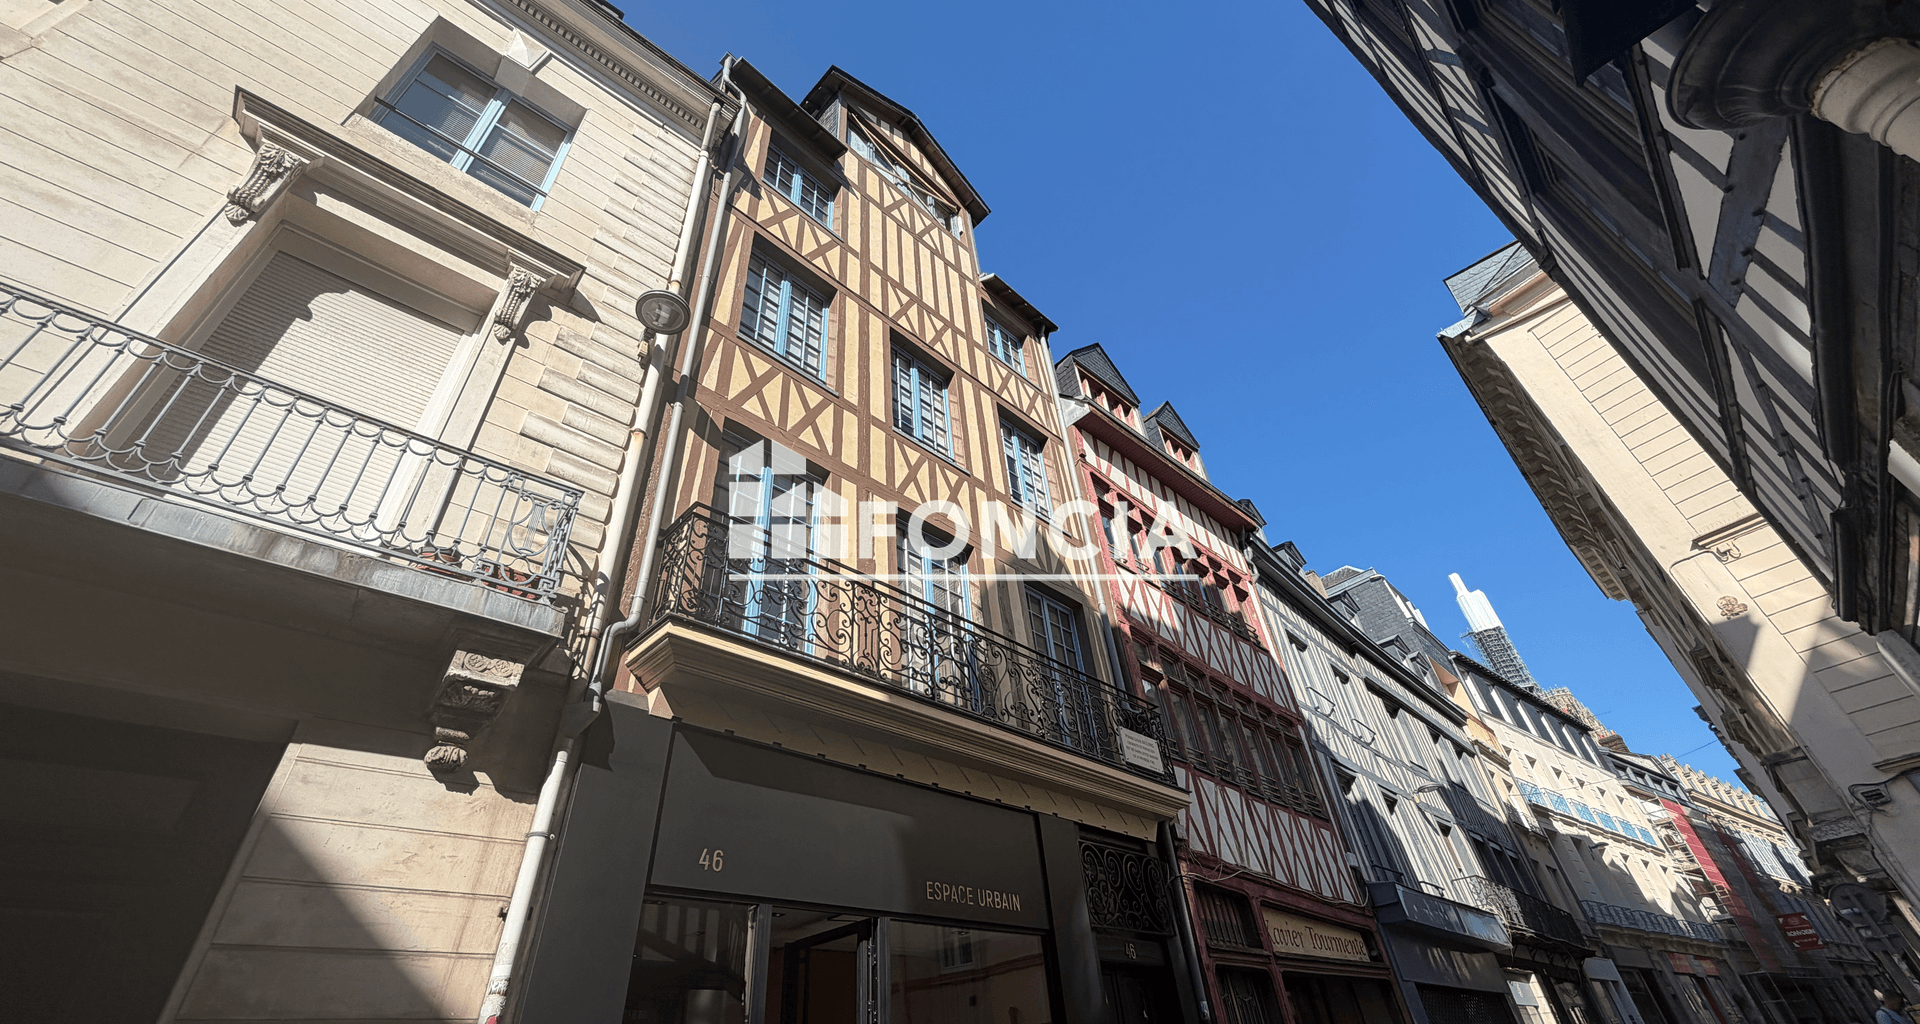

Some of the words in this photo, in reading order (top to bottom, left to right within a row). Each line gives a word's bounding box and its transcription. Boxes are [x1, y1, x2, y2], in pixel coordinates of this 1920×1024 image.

[699, 848, 723, 872] 46
[926, 881, 974, 905] ESPACE
[977, 888, 1021, 911] URBAIN
[1125, 943, 1136, 960] 46
[1304, 926, 1366, 956] Tourmente
